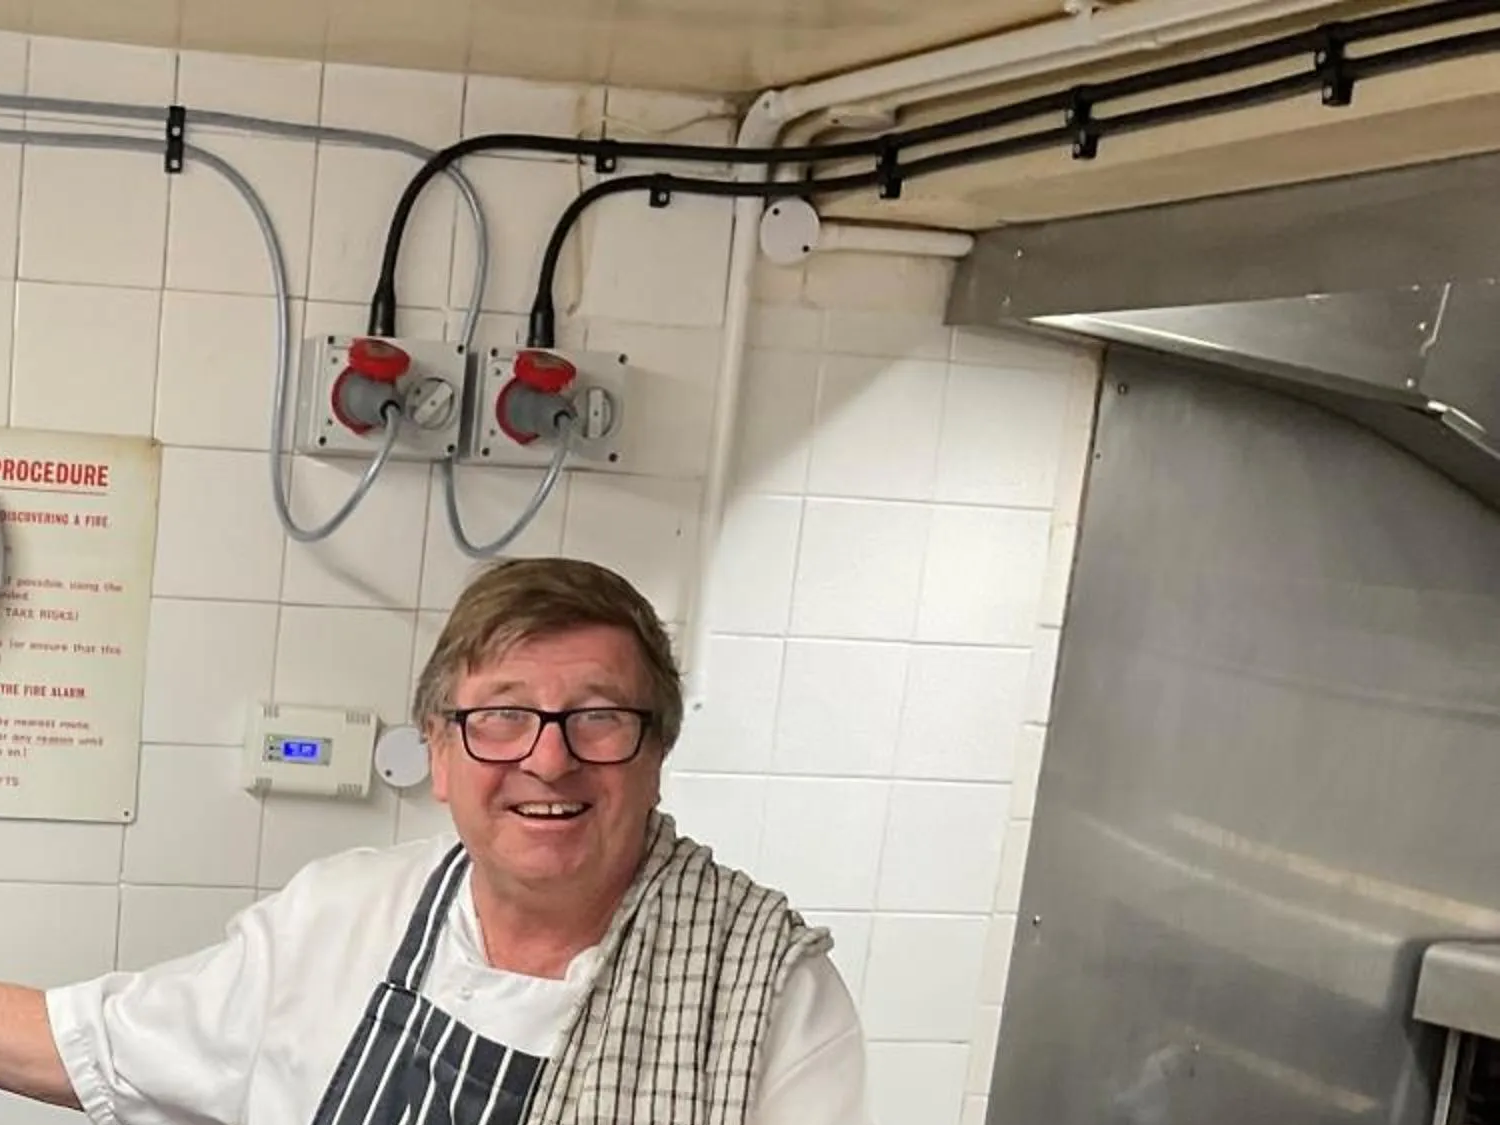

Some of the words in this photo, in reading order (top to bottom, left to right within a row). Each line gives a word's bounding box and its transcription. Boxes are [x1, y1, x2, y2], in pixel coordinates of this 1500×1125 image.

[85, 515, 109, 529] FIRE
[0, 684, 19, 696] THE
[24, 685, 47, 697] FIRE
[49, 686, 85, 698] ALARM
[14, 717, 56, 729] nearest
